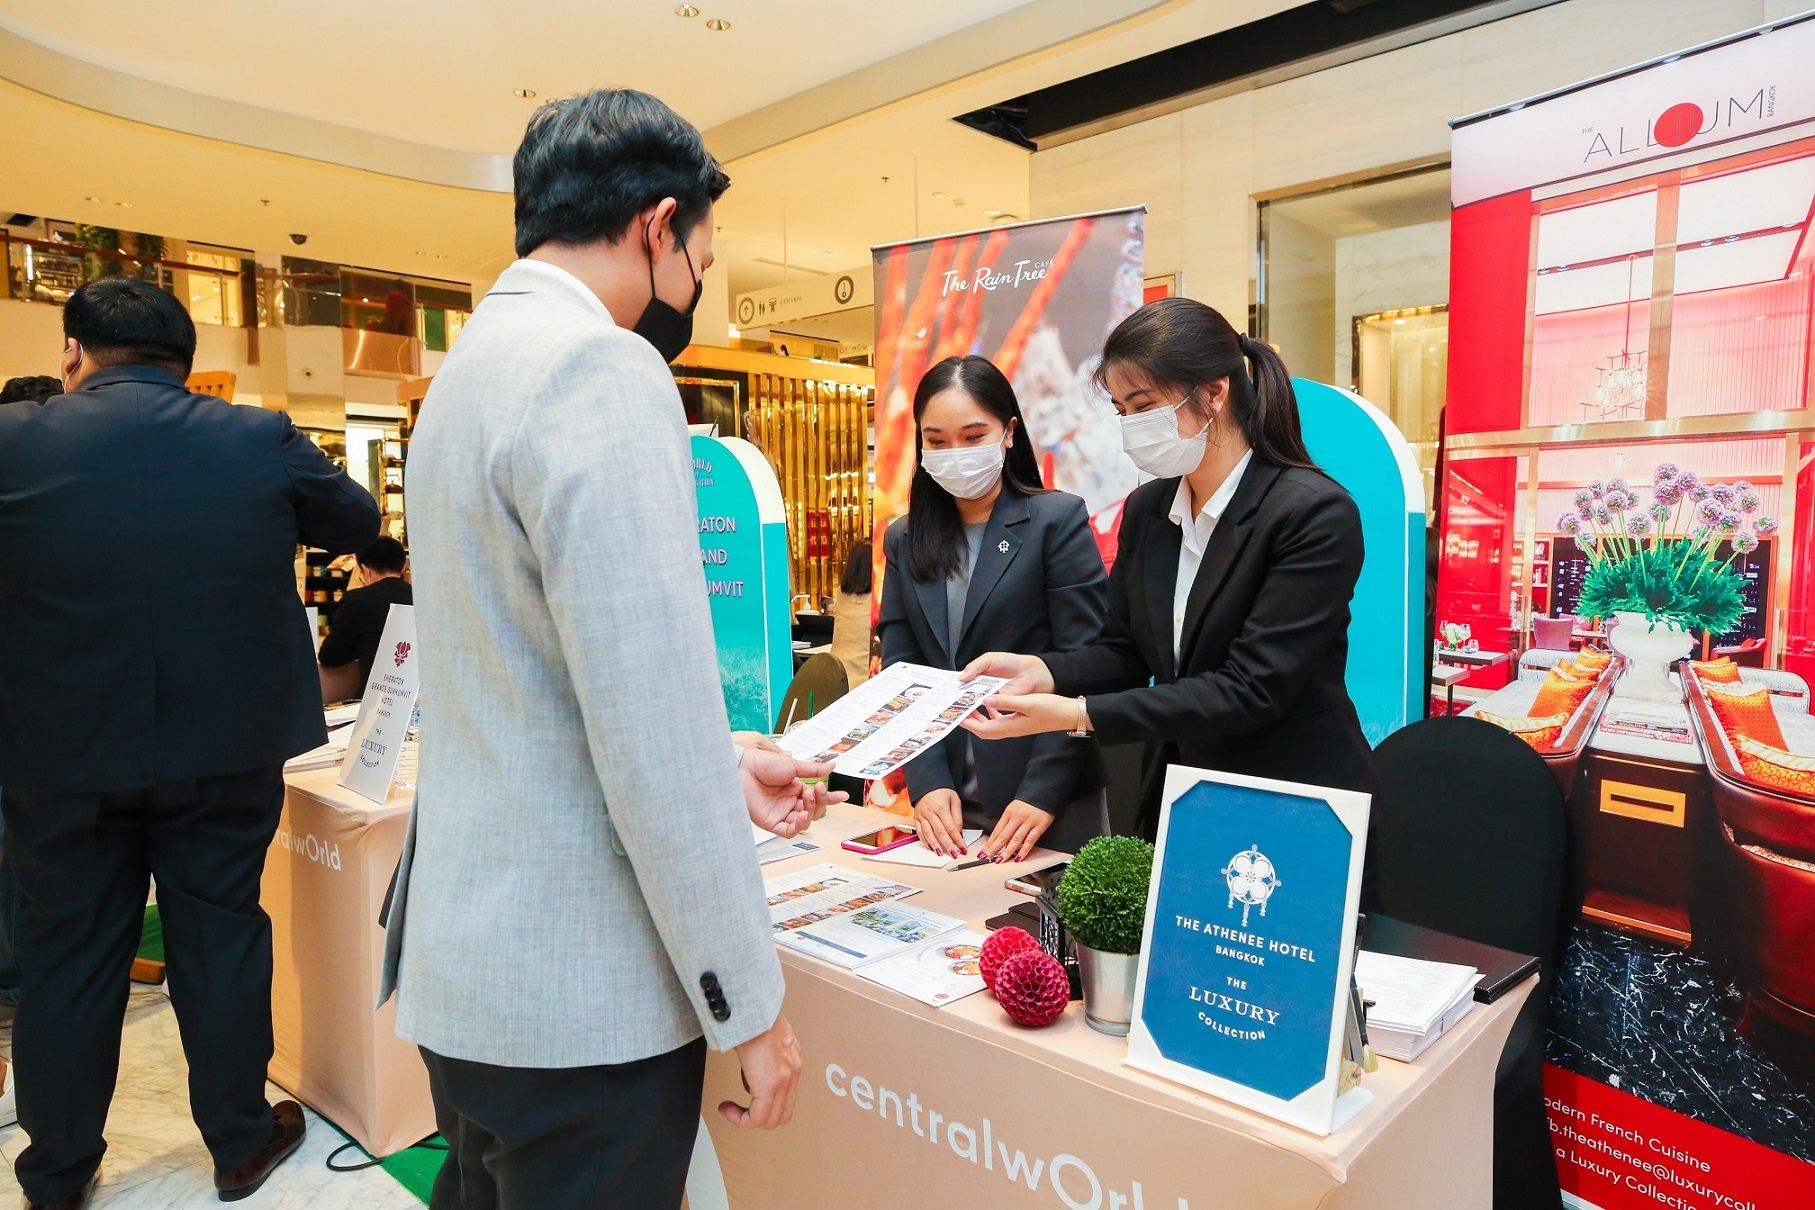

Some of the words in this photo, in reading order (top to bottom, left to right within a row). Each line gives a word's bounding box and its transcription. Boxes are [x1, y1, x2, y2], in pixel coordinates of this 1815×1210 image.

[1767, 84, 1777, 118] BANGKOK
[1581, 127, 1594, 135] THE
[942, 269, 970, 298] The
[699, 516, 736, 534] ATON
[360, 738, 388, 756] LUXURY
[1175, 915, 1200, 932] THE
[1203, 922, 1264, 948] ATHENEE
[1269, 939, 1316, 963] HOTEL
[1215, 944, 1265, 967] BANGKOK
[1226, 976, 1247, 990] THE
[1188, 986, 1281, 1025] LUXURY
[1198, 1011, 1266, 1040] COLLECTION
[1590, 1114, 1644, 1146] French
[1648, 1138, 1711, 1173] Cuisine
[1546, 1117, 1756, 1210] b.theathenee@luxurycoll
[1556, 1147, 1566, 1159] a
[1570, 1150, 1622, 1185] Luxury
